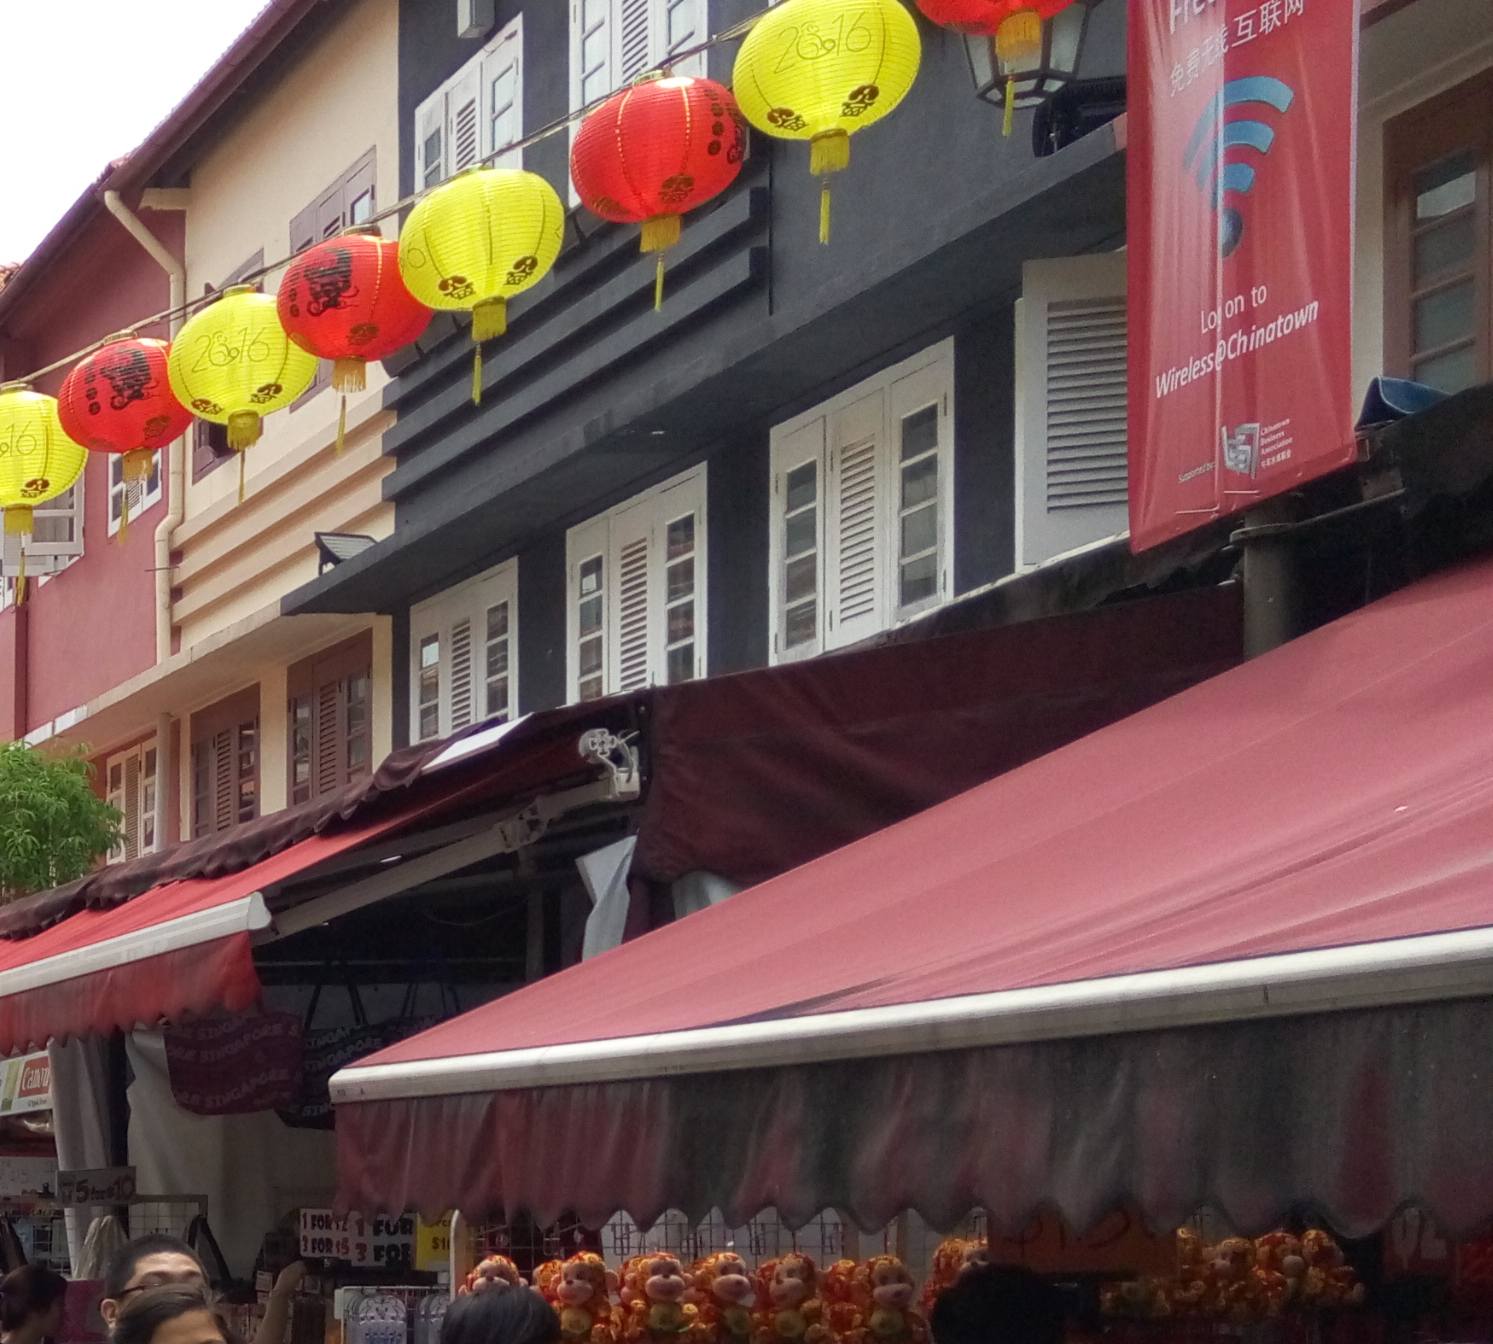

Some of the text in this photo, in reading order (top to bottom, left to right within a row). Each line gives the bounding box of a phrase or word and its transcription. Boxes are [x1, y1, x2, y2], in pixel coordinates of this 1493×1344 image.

[1225, 295, 1245, 319] on
[1251, 285, 1267, 307] to
[1156, 300, 1319, 399] Wireless@Chinatown
[311, 1237, 333, 1254] FOR
